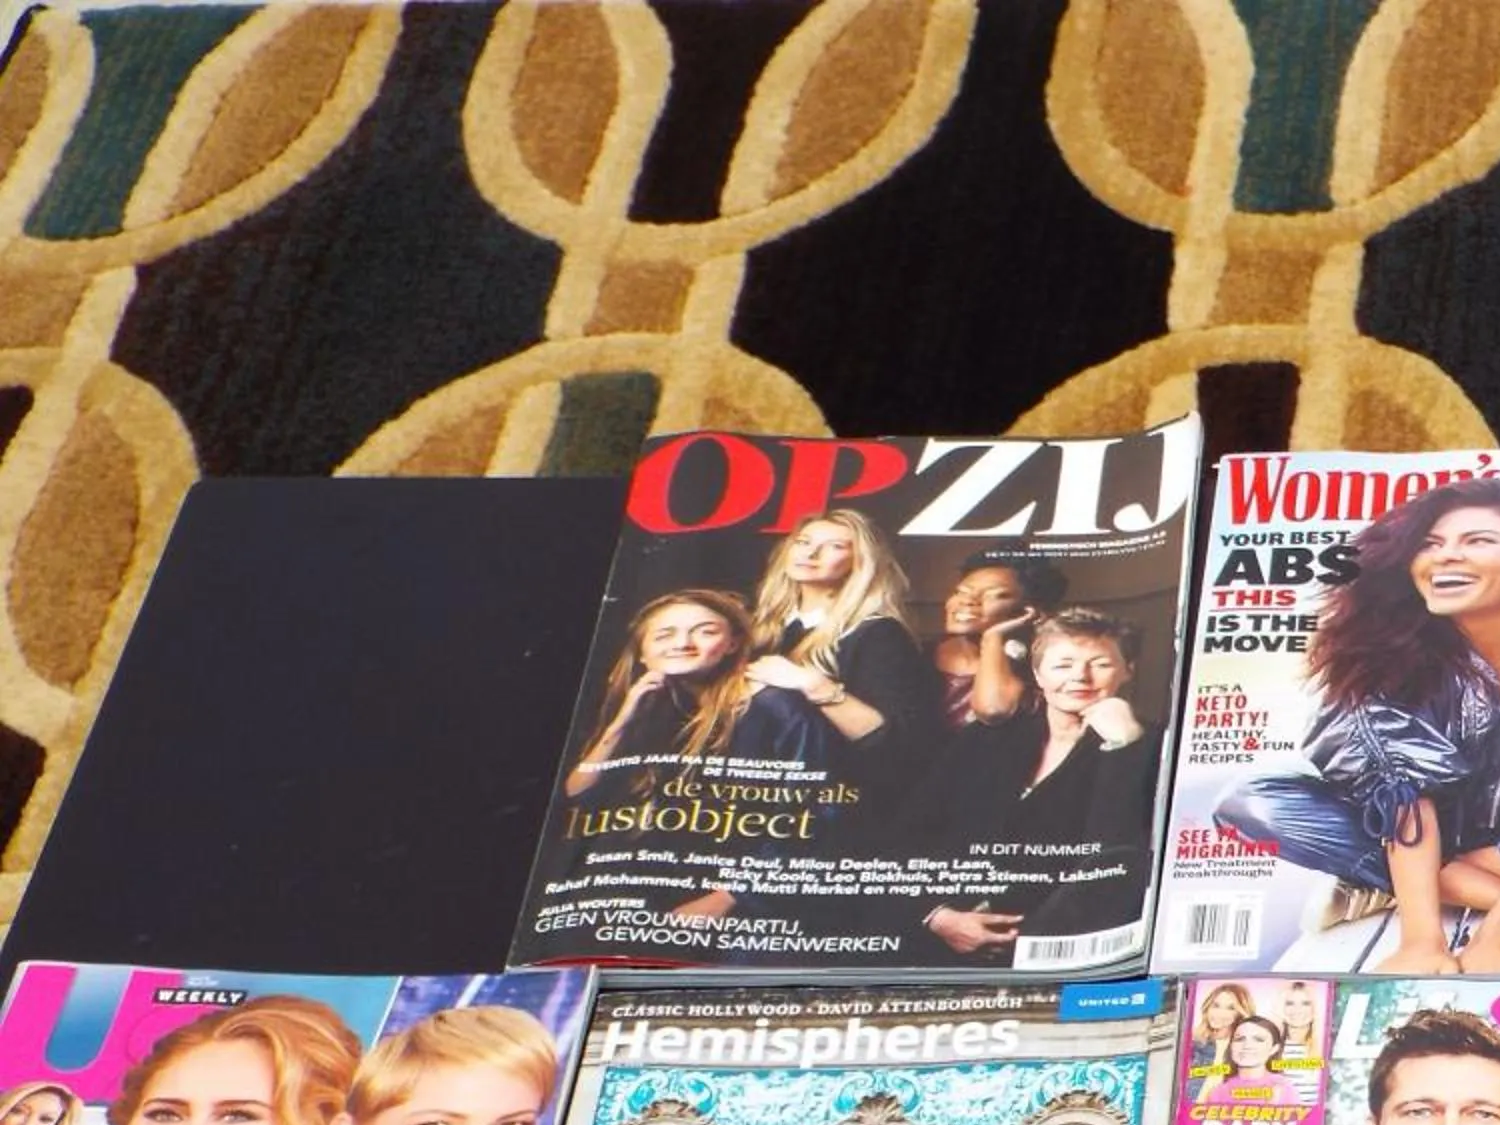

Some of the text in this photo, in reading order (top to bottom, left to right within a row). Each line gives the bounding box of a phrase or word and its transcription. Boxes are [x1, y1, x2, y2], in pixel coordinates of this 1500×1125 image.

[1221, 531, 1350, 547] YOUR BEST
[1213, 545, 1361, 587] ABS
[1212, 590, 1297, 606] THIS
[1207, 615, 1318, 632] IS THE
[1203, 636, 1307, 653] MOVE
[1196, 695, 1248, 711] KETO
[1193, 711, 1268, 728] PARTY!
[1189, 753, 1254, 765] RECIPES
[664, 777, 859, 804] de vrouw als
[565, 800, 816, 843] lustobject
[1024, 843, 1101, 857] NUMMER
[535, 909, 804, 936] GEEN VROUWENPARTIJ,
[595, 926, 901, 952] GEWOON SAMENWERKEN
[158, 990, 243, 1003] WEEKLY
[1078, 997, 1130, 1007] UNITED
[612, 1004, 683, 1018] CLASSIC
[689, 1003, 801, 1017] HOLLYWOOD
[819, 1001, 872, 1016] DAVID
[879, 997, 1023, 1013] ATTENBOROUGH
[604, 1018, 1021, 1069] Hemispheres
[1190, 1105, 1312, 1121] CELEBRITY
